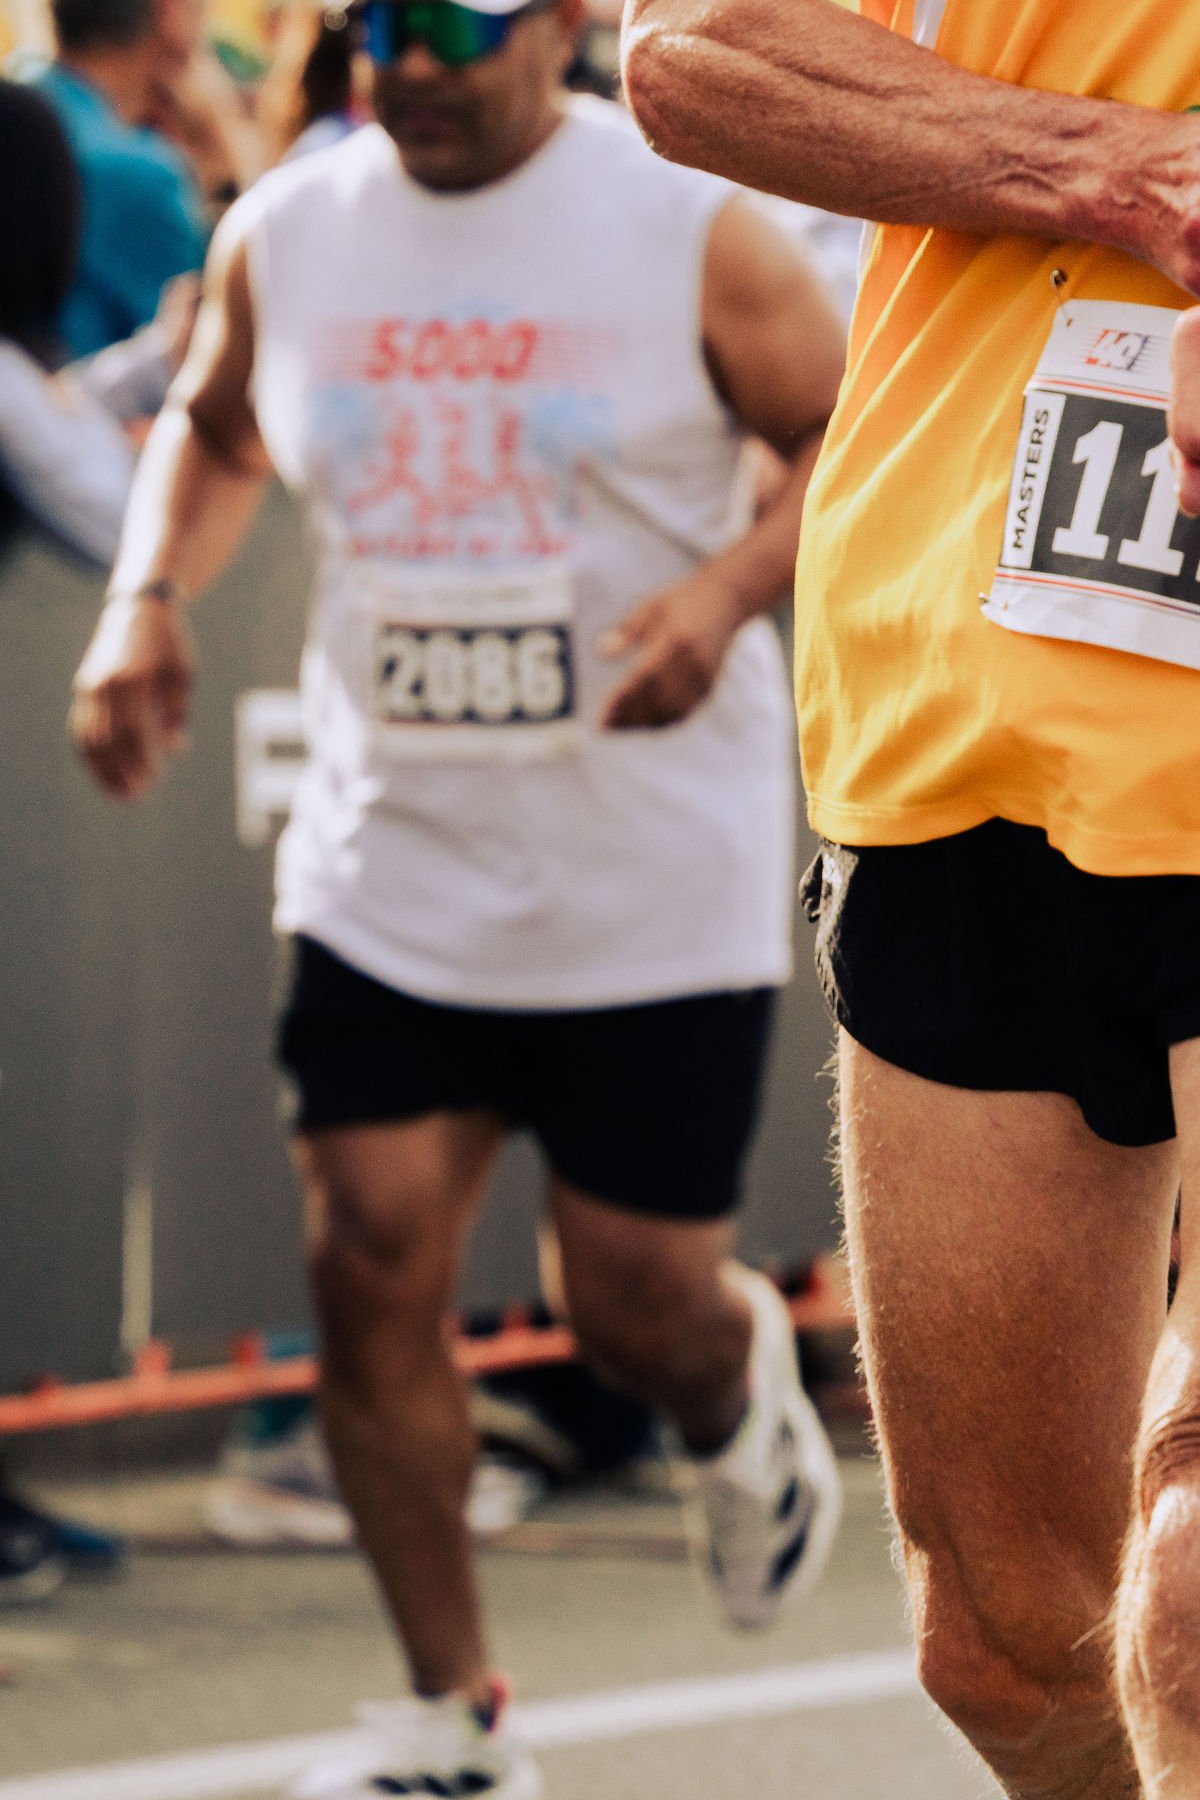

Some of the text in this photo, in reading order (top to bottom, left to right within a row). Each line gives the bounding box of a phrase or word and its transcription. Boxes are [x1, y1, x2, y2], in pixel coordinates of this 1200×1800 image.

[366, 317, 540, 381] 5000
[1010, 406, 1051, 553] MASTERS
[377, 625, 566, 721] 2086
